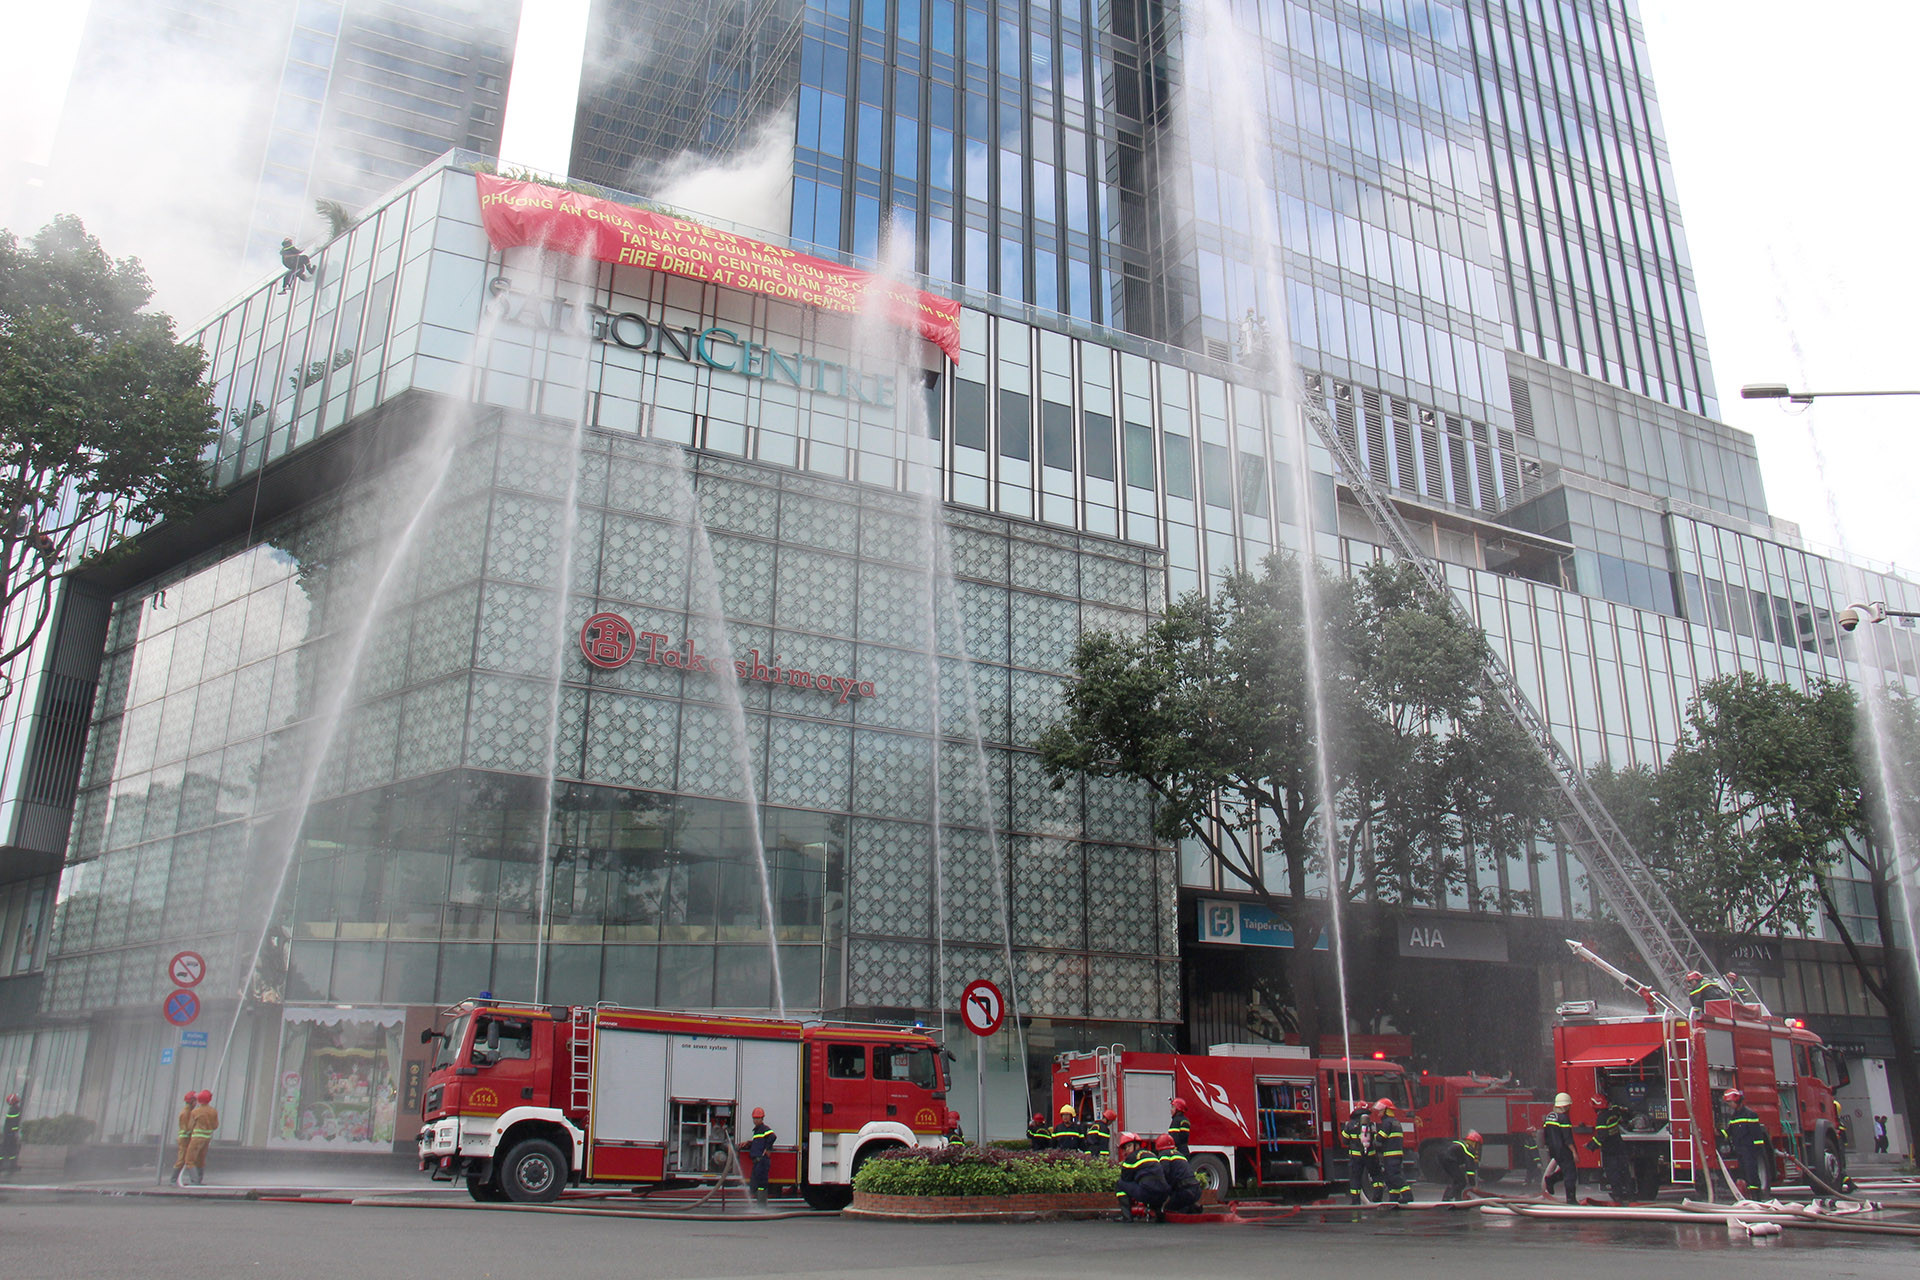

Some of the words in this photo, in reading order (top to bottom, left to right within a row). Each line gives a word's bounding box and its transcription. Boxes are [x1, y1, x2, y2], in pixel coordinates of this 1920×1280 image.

[481, 193, 554, 211] PHƯƠNG
[559, 201, 582, 217] ÁN
[587, 209, 634, 230] CHỮA
[638, 224, 683, 242] CHÁY
[687, 234, 710, 249] VÀ
[714, 241, 747, 257] CỨU
[618, 247, 659, 268] FIRE
[661, 259, 709, 279] DRILL
[712, 268, 736, 284] AT
[738, 274, 800, 300] SAIGON
[620, 230, 647, 248] TẠI
[651, 239, 714, 264] SAIGON
[718, 255, 784, 280] CENTRE
[787, 272, 821, 293] NĂM
[824, 284, 857, 305] 2023
[639, 630, 878, 704] Takashimaya
[1410, 927, 1446, 948] AIA
[476, 1094, 492, 1103] 114
[920, 1114, 933, 1122] 114
